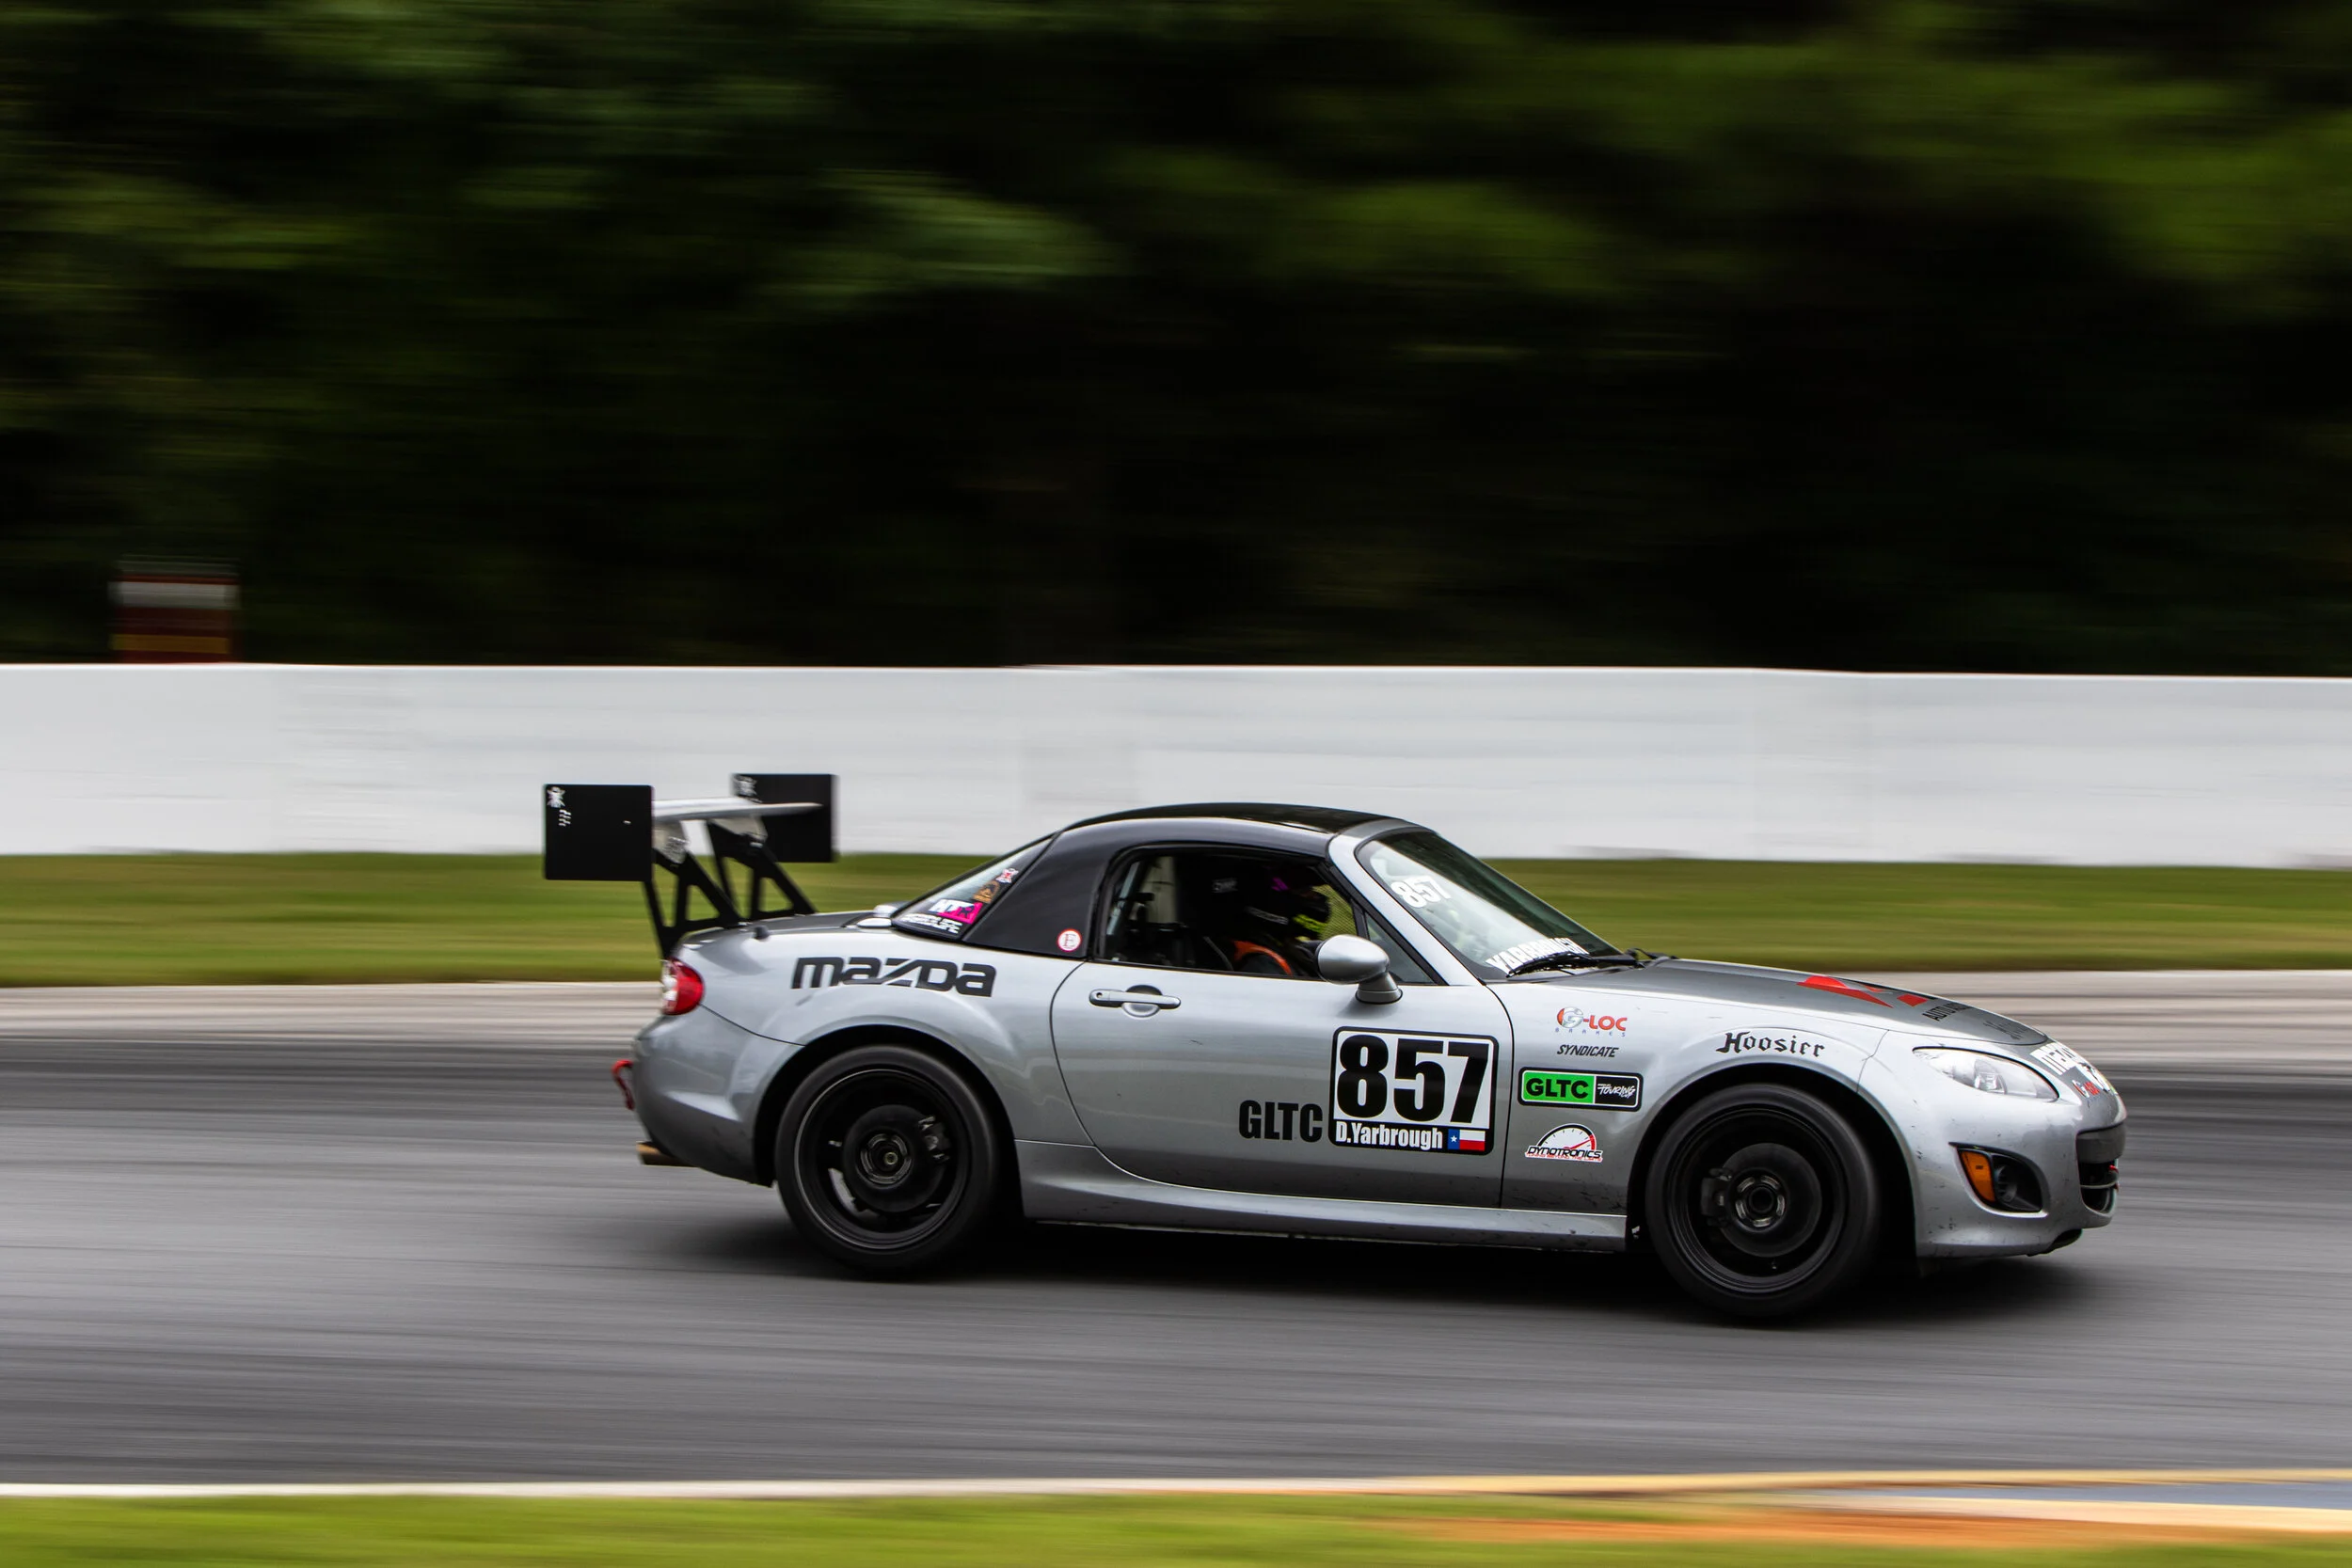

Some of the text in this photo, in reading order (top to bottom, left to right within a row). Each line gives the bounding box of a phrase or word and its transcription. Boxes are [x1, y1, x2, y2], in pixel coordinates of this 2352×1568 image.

[1391, 875, 1451, 909] 857
[1062, 934, 1076, 946] E
[1557, 1006, 1628, 1032] G-LOC
[1557, 1044, 1619, 1058] SYNDICATE
[1715, 1031, 1825, 1058] Hoosier
[1336, 1034, 1489, 1123] 857
[1526, 1078, 1589, 1099] GLTC
[1239, 1100, 1323, 1143] GLTC
[1336, 1120, 1443, 1151] D.Yarbrough
[1528, 1147, 1601, 1159] DYNOTRONICS
